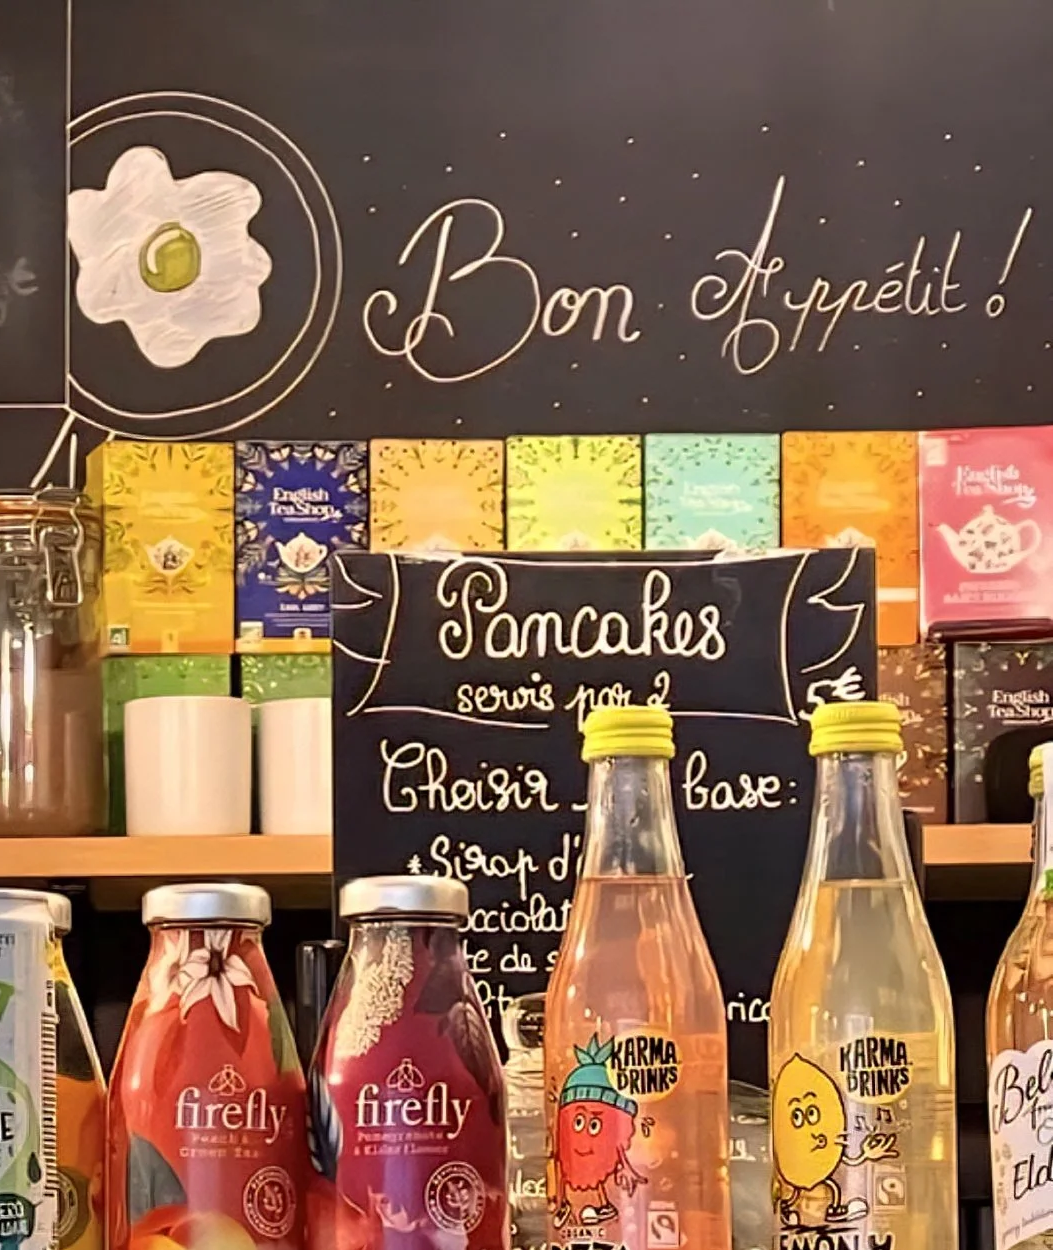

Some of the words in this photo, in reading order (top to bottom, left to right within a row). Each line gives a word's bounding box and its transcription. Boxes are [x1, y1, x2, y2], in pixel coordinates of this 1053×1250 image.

[363, 198, 641, 382] Bon
[691, 176, 967, 374] Appétit
[273, 486, 329, 502] English
[436, 560, 728, 660] Pancakes
[992, 690, 1050, 708] English
[380, 739, 559, 813] Choisir
[500, 943, 538, 972] de
[610, 1035, 677, 1067] KARMA
[839, 1037, 908, 1072] KARMA
[616, 1065, 678, 1095] DRINKS
[846, 1065, 910, 1097] DRINKS
[992, 1049, 1053, 1134] Bel
[175, 1086, 287, 1144] firefly
[355, 1082, 473, 1139] firefly
[1013, 1143, 1053, 1200] Eld
